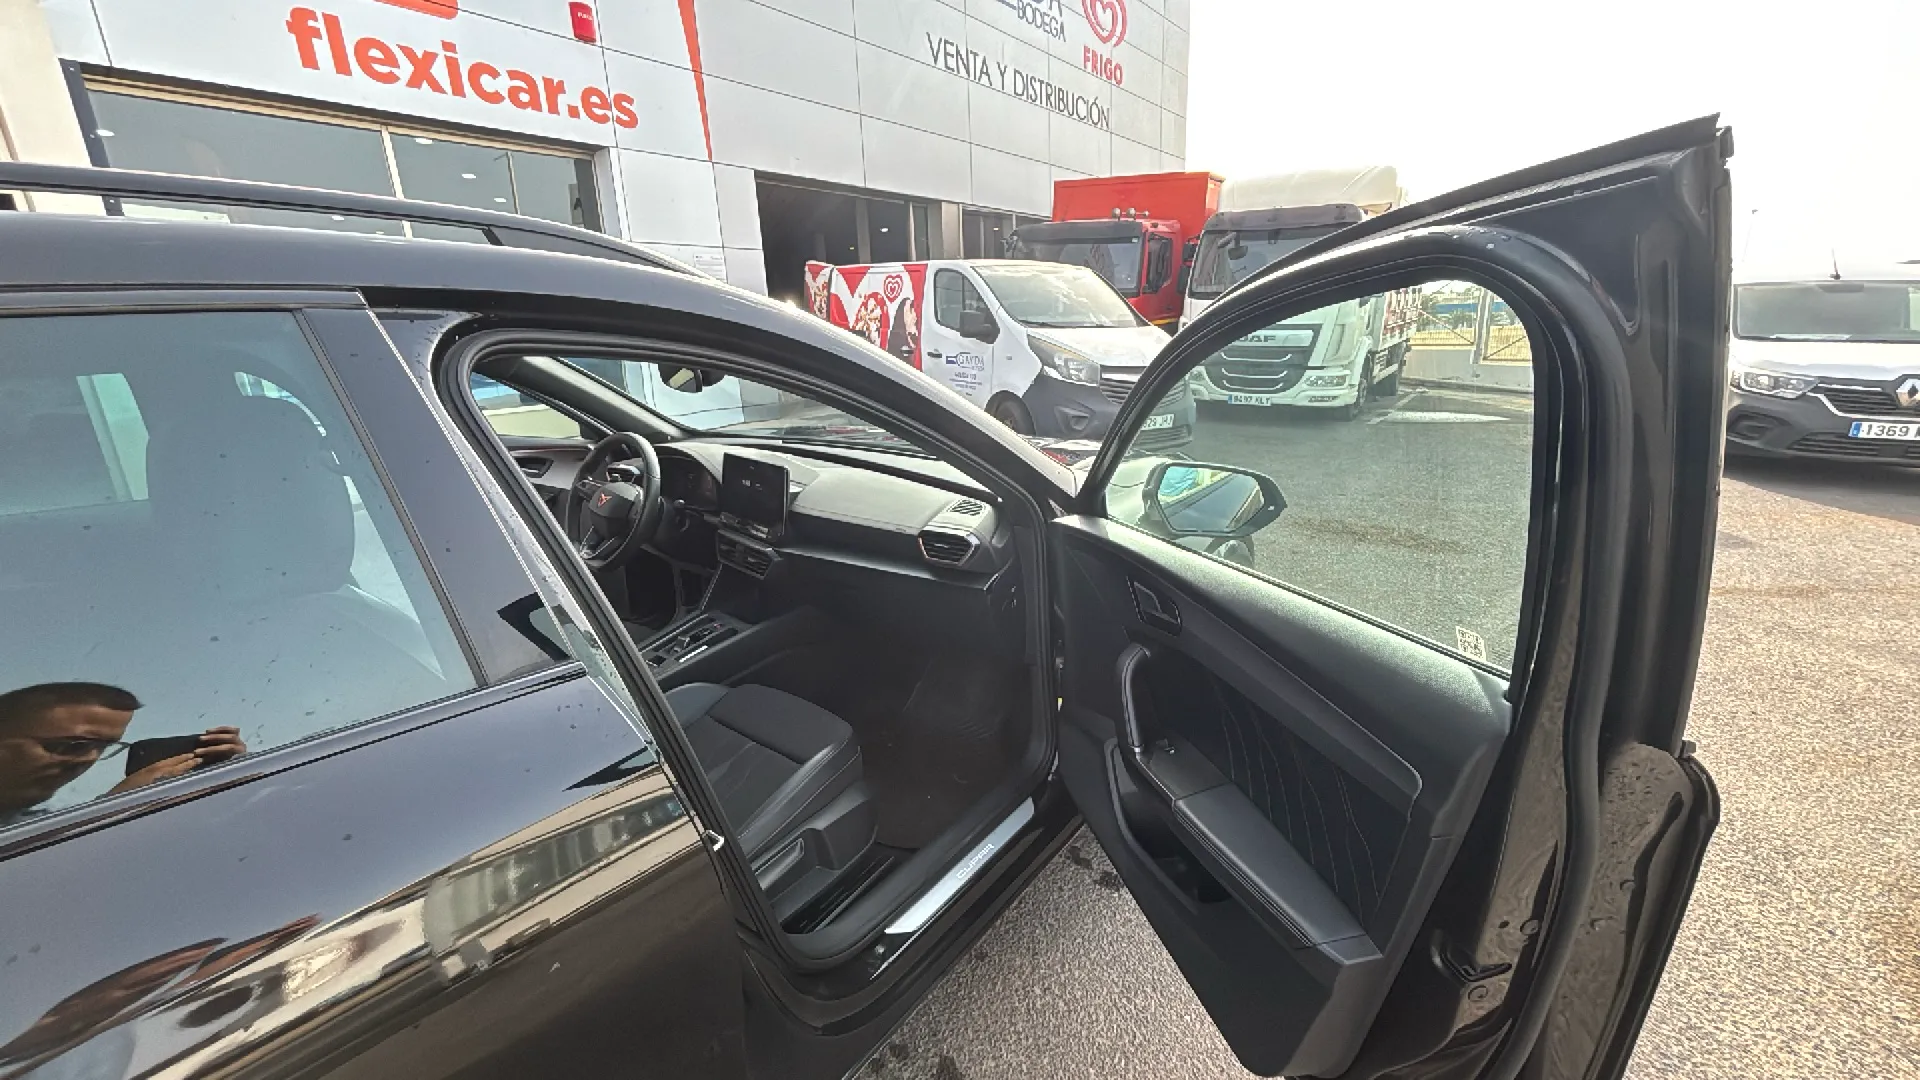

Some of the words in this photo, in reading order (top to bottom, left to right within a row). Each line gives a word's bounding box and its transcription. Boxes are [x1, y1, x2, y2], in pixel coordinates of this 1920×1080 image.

[1017, 0, 1066, 42] BODEGA
[286, 7, 639, 129] flexicar.es
[926, 31, 992, 87] VENTA
[996, 61, 1007, 91] Y
[1014, 68, 1110, 129] DISTRIBUCIÓN
[1083, 44, 1123, 86] FRIGO
[1866, 424, 1910, 437] 1369
